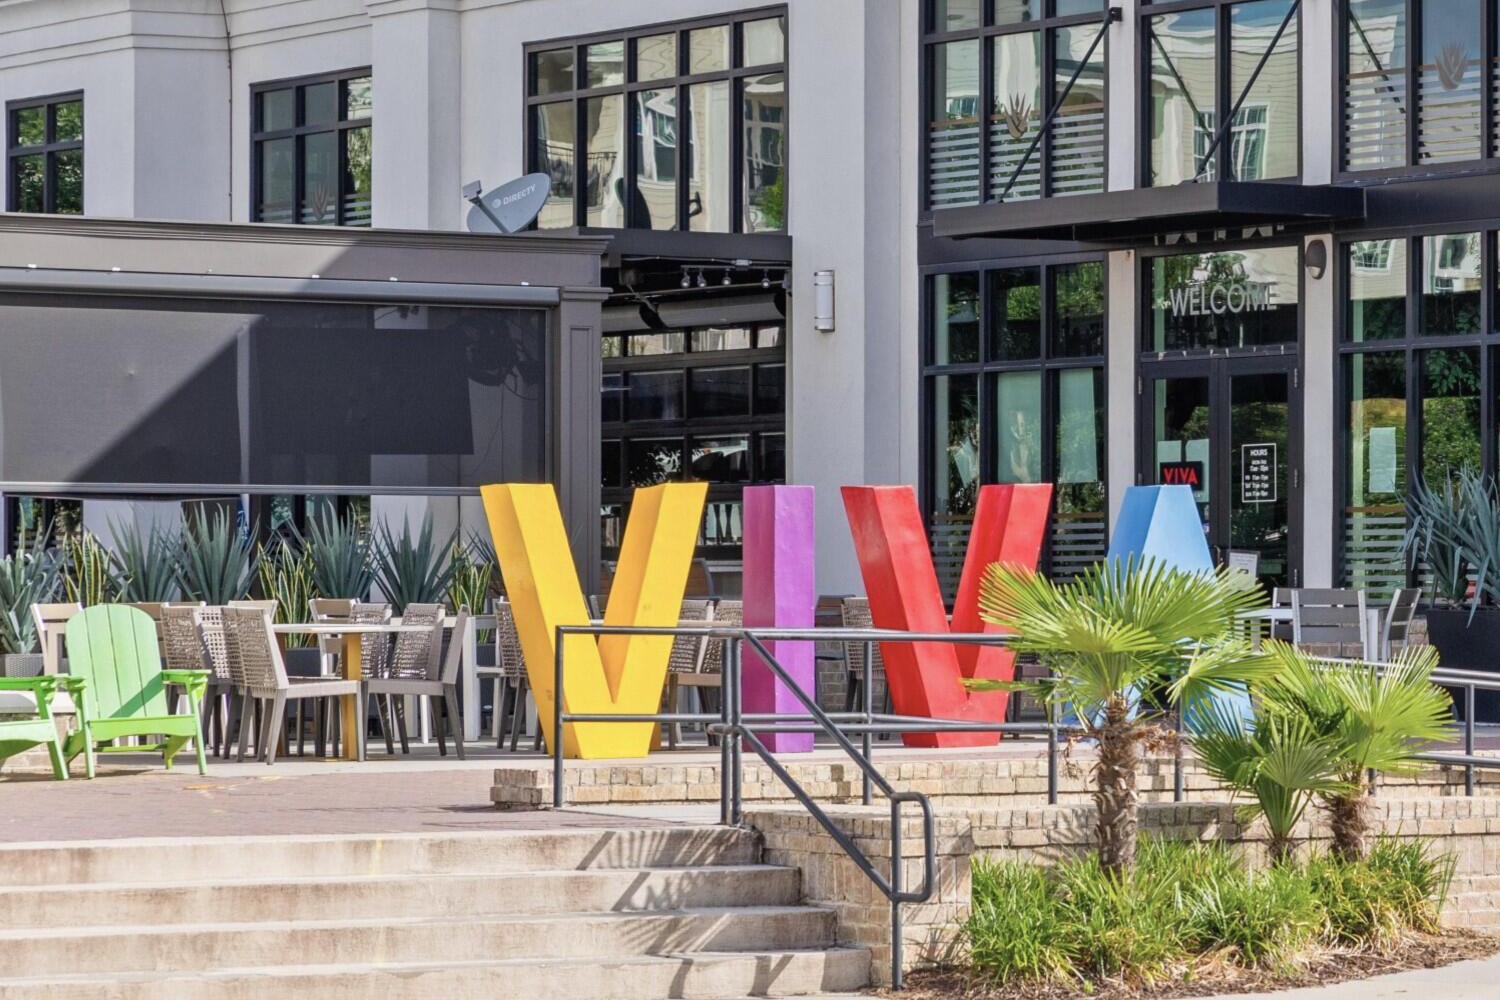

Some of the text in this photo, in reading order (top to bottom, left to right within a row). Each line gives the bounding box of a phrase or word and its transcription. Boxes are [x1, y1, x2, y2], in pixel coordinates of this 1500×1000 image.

[503, 183, 536, 205] DIRECTV
[1170, 281, 1277, 317] WELCOME
[1163, 466, 1198, 485] VIVA
